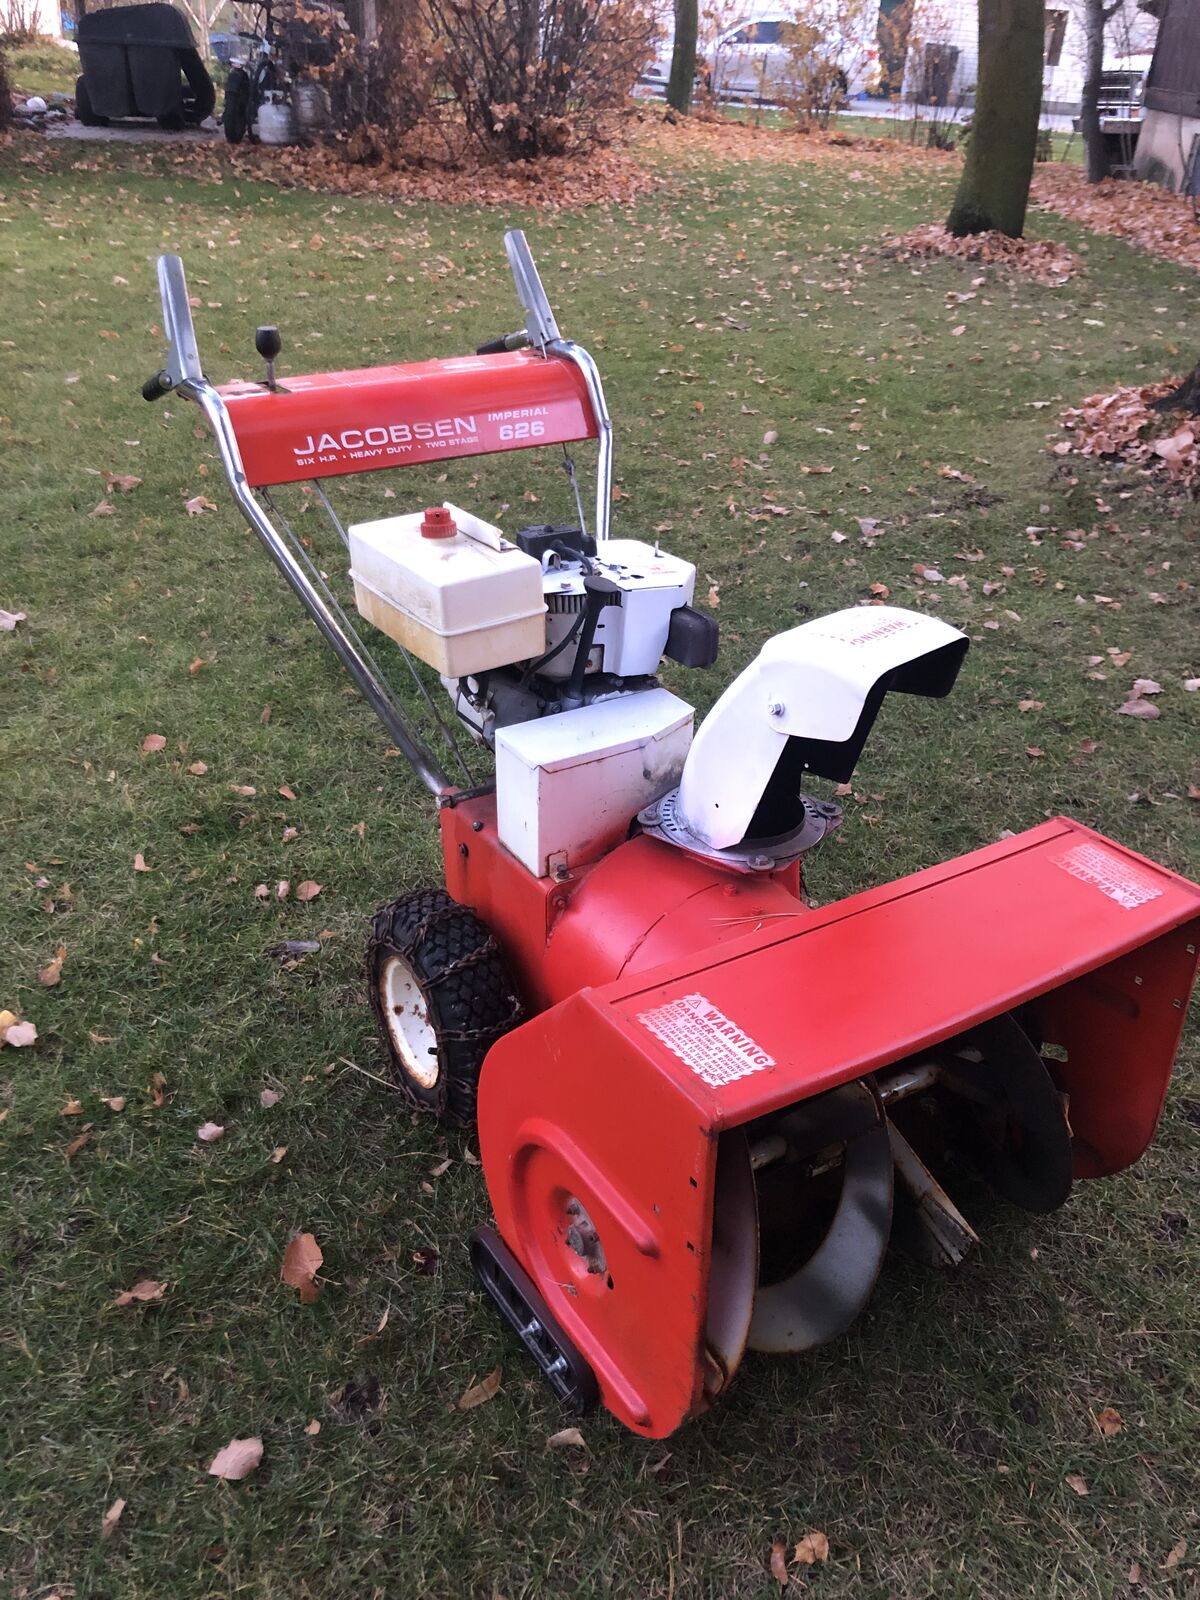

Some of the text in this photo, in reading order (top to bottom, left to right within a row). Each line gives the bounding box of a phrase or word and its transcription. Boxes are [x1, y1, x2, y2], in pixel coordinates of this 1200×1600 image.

[293, 407, 549, 455] JACOBSEN IMPERIAL 626
[296, 456, 315, 466] SIX
[350, 448, 383, 459] HEAVY
[387, 445, 412, 454] DUTY
[425, 440, 446, 449] TWO
[448, 436, 479, 446] STAGE
[675, 1001, 715, 1034] DANGER
[703, 1010, 769, 1065] WARNING
[681, 1024, 695, 1035] STOP
[716, 1056, 738, 1075] REMOVE
[690, 1024, 715, 1045] ROTATING
[722, 1053, 744, 1072] MOVING
[693, 1044, 712, 1059] BEFORE
[709, 1059, 732, 1077] MAKING
